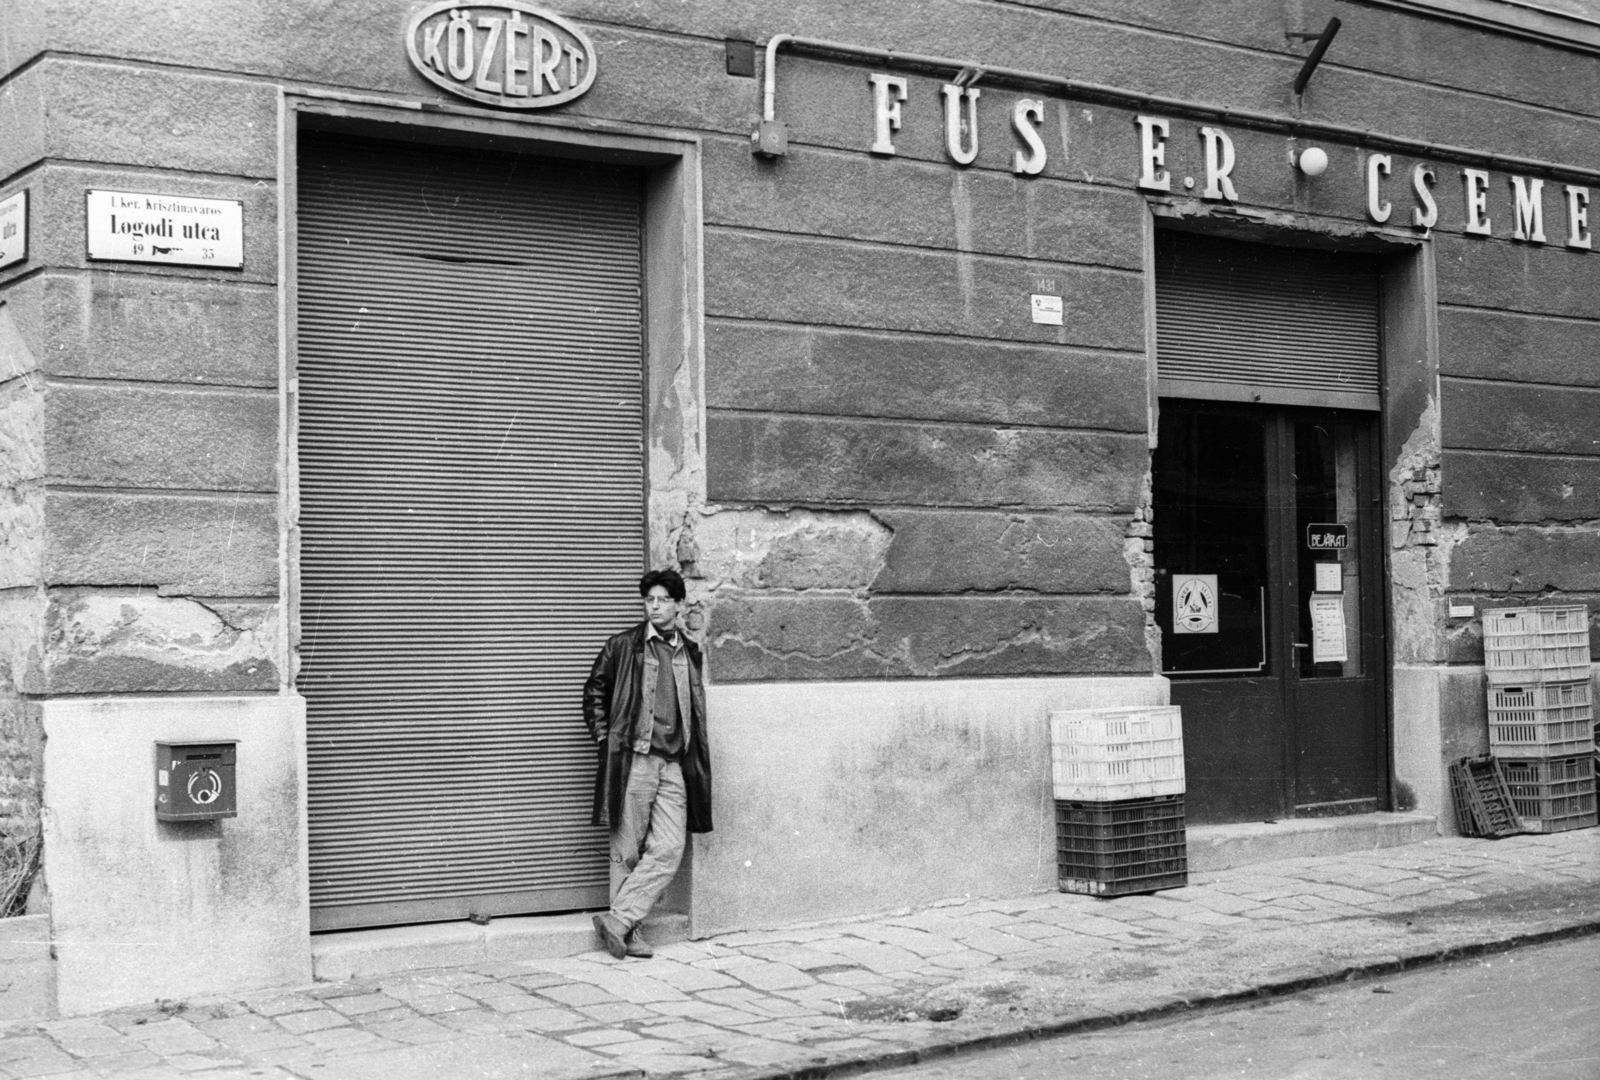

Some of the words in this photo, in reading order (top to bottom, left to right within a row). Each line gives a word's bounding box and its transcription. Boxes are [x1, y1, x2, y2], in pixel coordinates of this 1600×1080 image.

[423, 8, 584, 97] KÖZÉRT
[120, 196, 141, 209] ker.
[110, 213, 174, 242] Logodi
[182, 221, 221, 242] utca
[1311, 532, 1346, 548] BEJÁRAT
